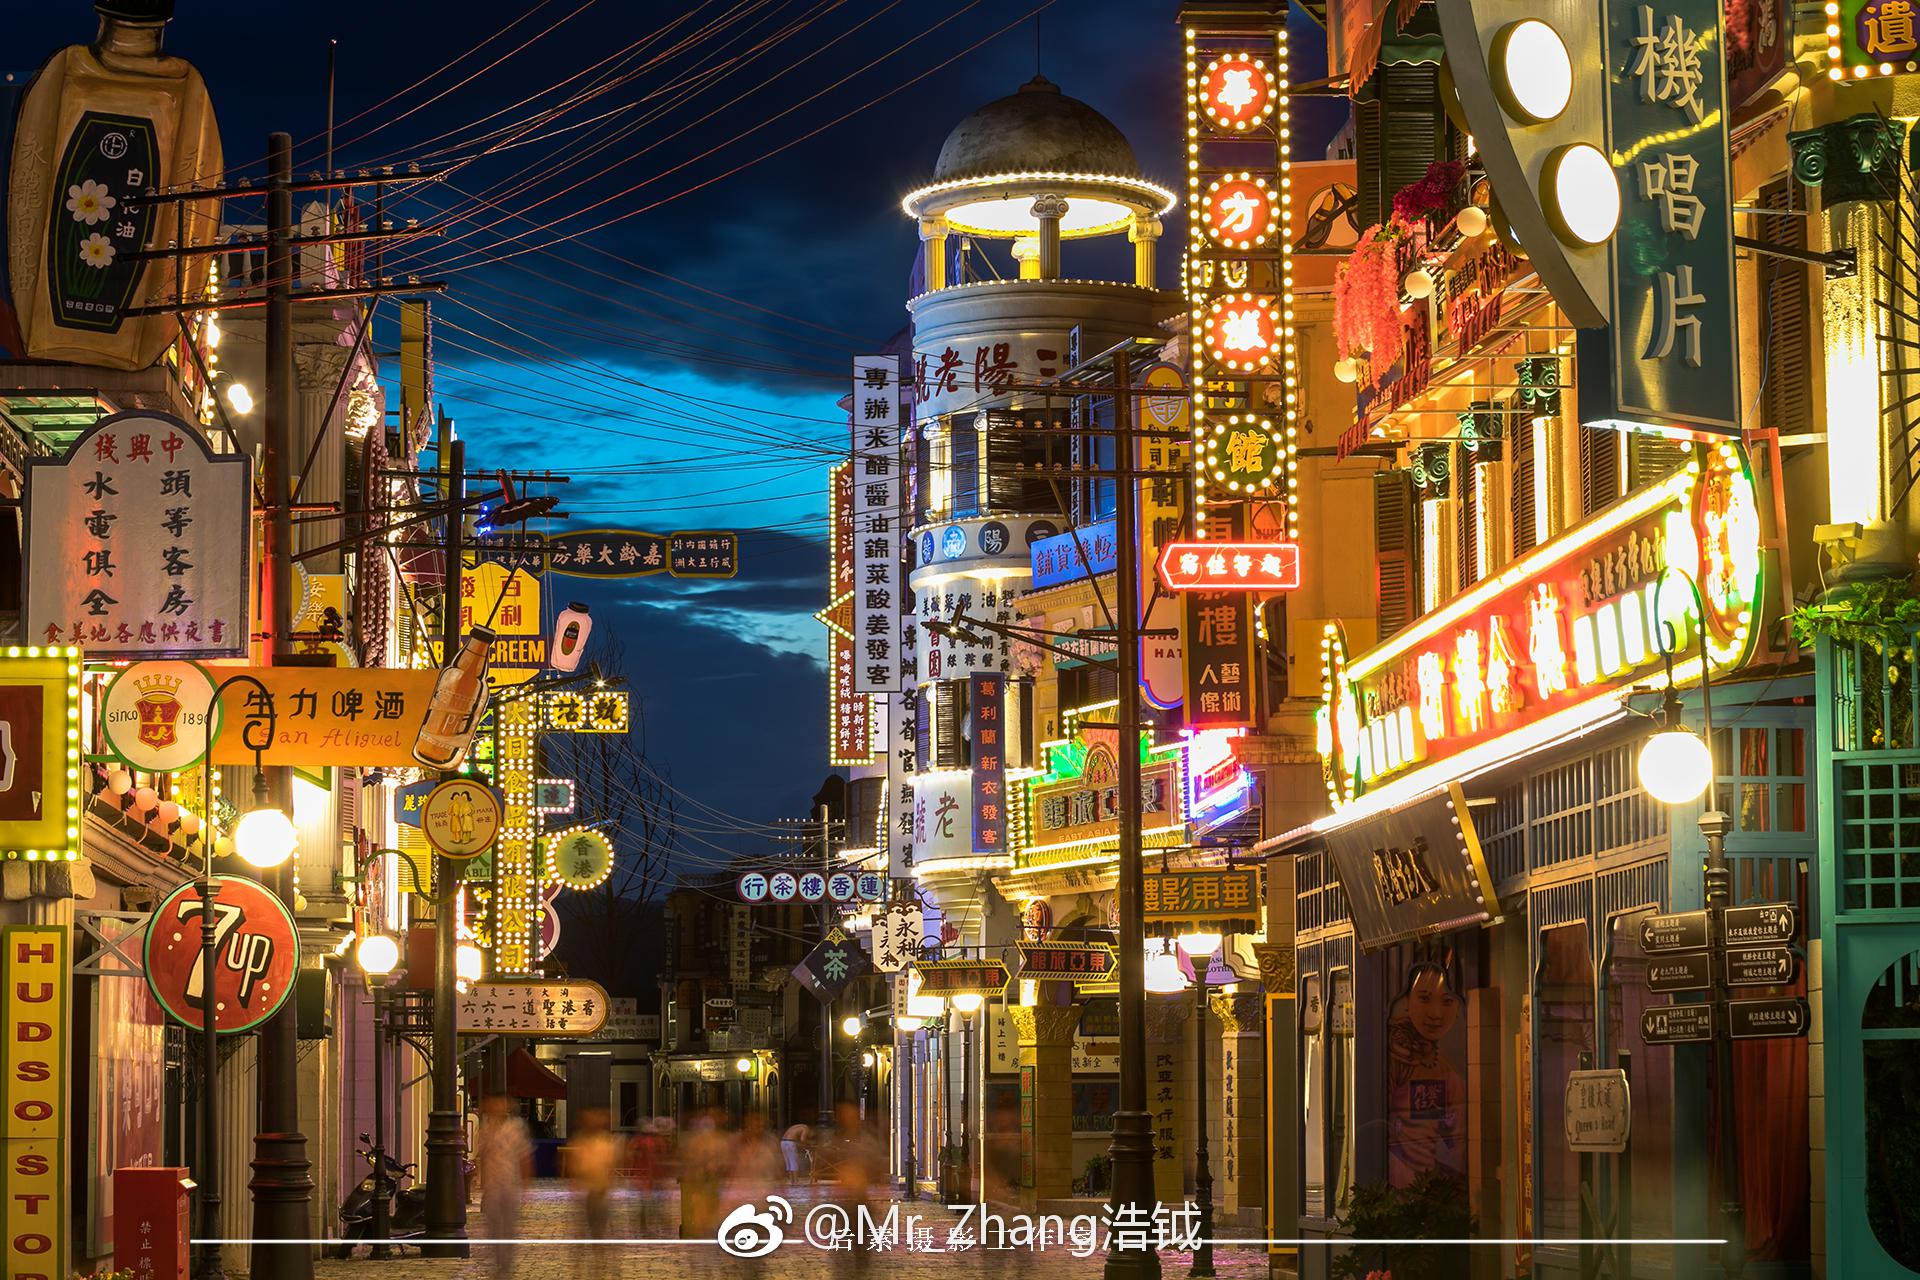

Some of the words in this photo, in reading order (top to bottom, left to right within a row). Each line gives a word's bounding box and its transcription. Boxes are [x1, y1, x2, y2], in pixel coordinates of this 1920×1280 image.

[1632, 4, 1707, 367] 機唱片
[94, 431, 185, 464] 中興棧
[81, 471, 119, 616] 水電俱全
[159, 469, 194, 615] 頭等客房
[244, 687, 405, 722] 生力啤酒
[503, 701, 529, 969] 大同食品有限公司
[1058, 833, 1085, 843] EAST
[1088, 827, 1111, 838] ASIA
[572, 836, 594, 879] 香港
[744, 876, 880, 898] 蓮香樓茶行
[895, 918, 919, 957] 永利
[824, 949, 849, 981] 茶
[1031, 952, 1106, 972] 東亞旅館
[14, 943, 54, 1122] HUDSO
